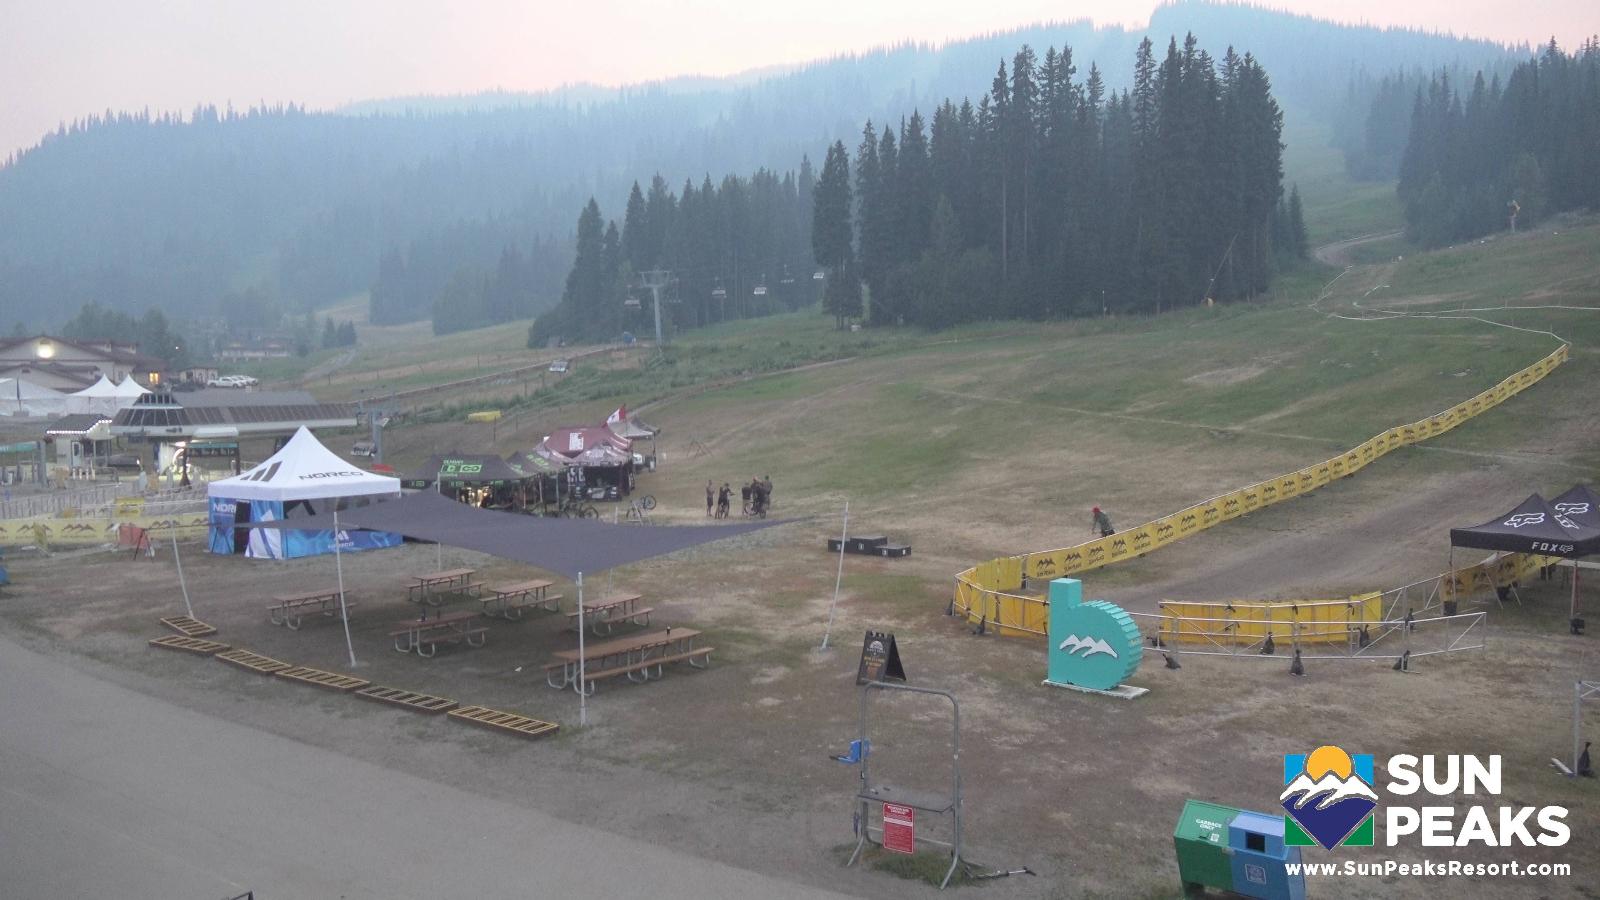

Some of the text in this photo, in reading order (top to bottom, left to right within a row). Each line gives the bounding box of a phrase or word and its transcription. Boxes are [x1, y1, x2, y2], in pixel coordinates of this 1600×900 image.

[299, 471, 364, 480] NORCO
[213, 503, 236, 513] NOR
[1531, 541, 1558, 552] FOX
[1195, 818, 1222, 829] GARBAGE
